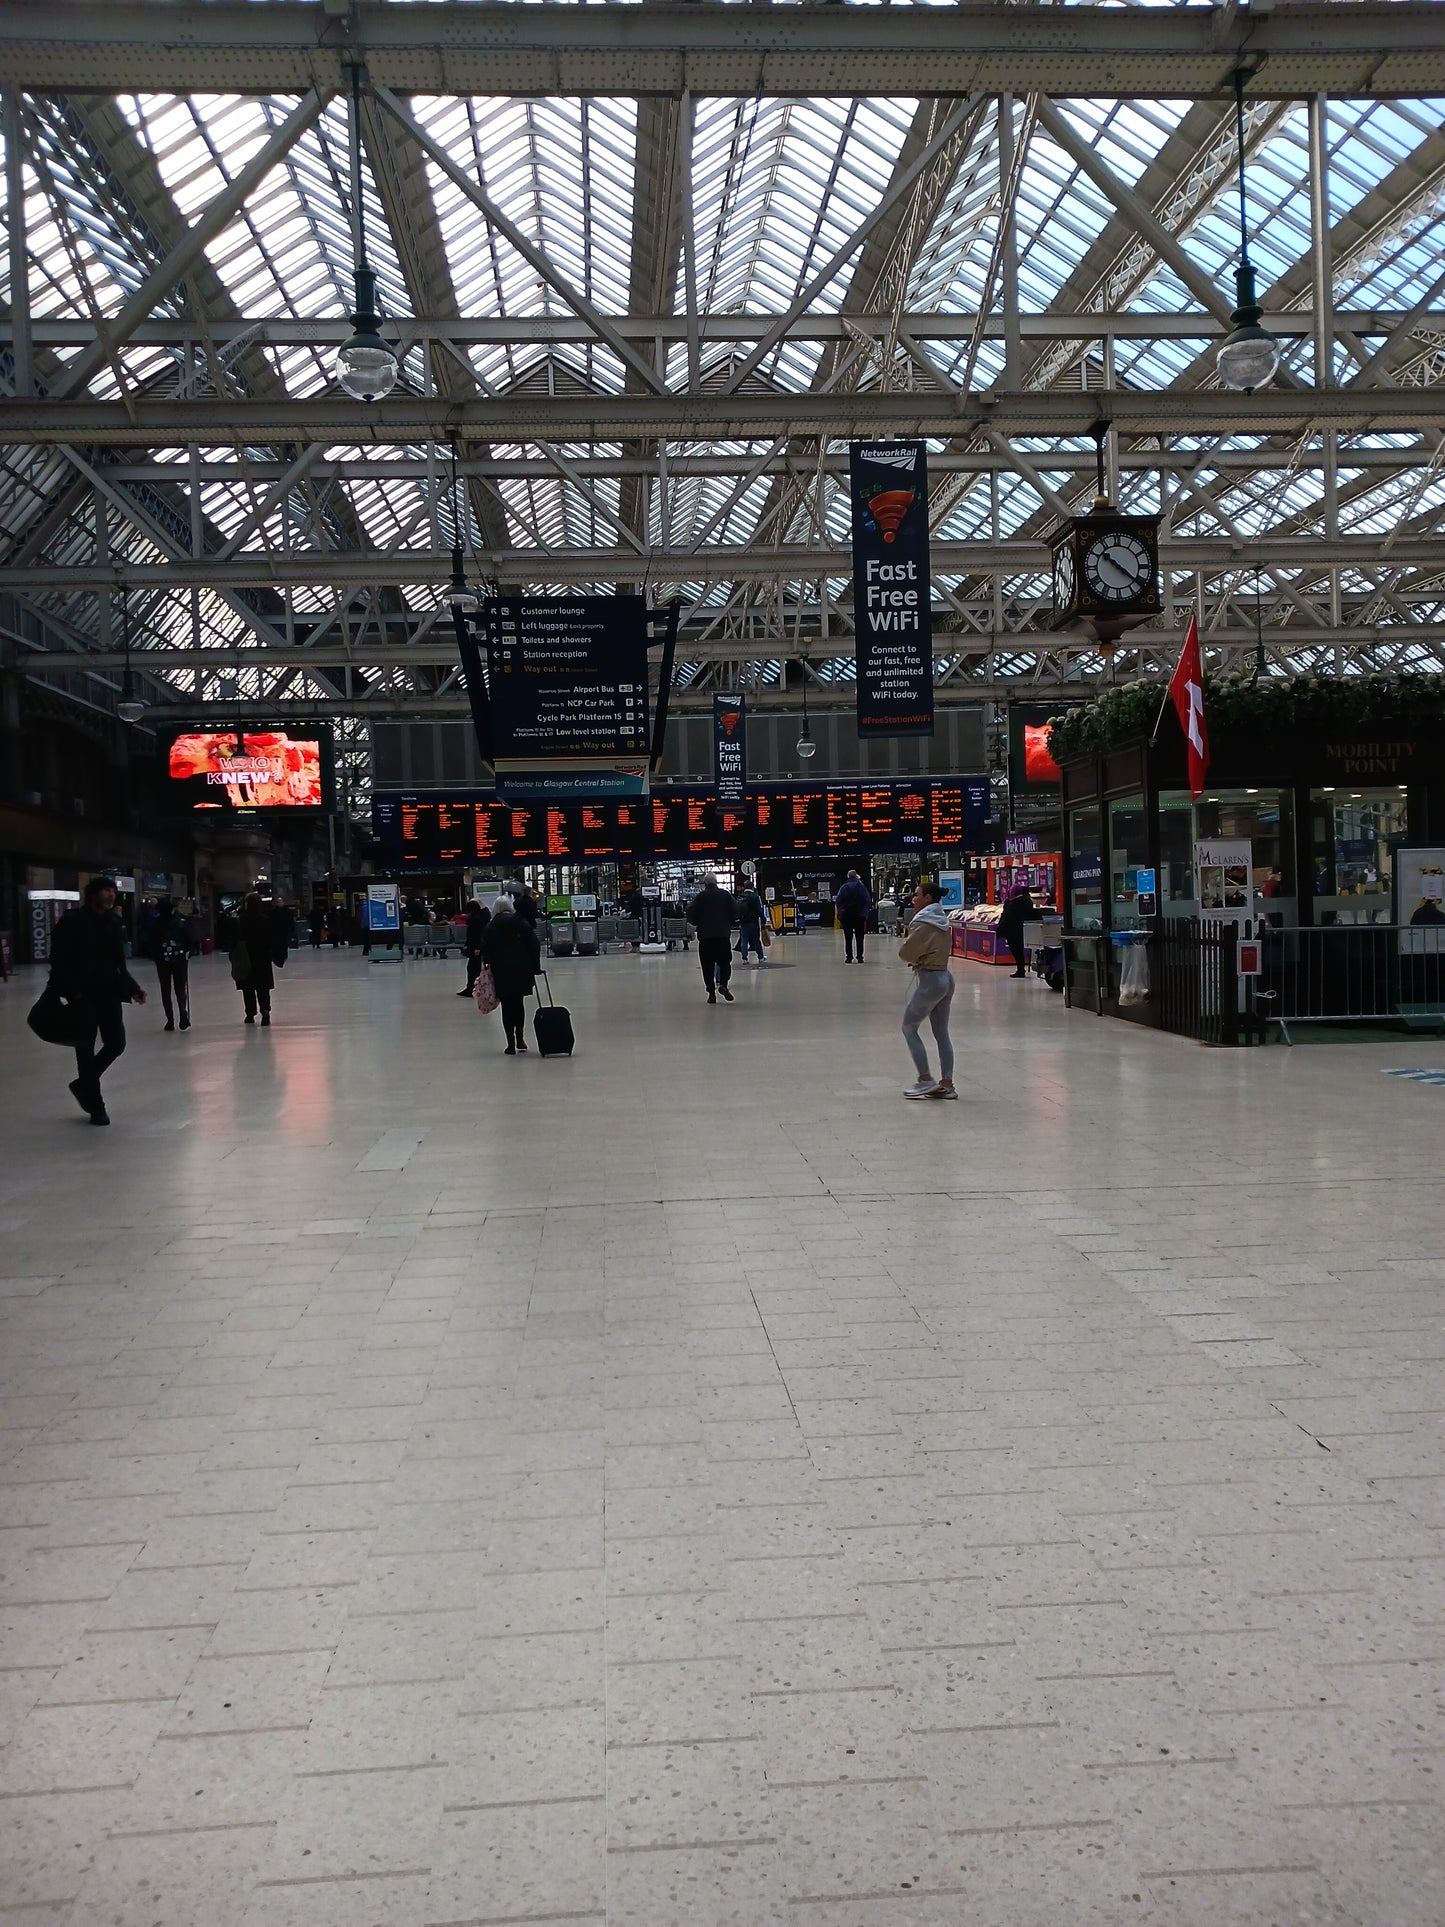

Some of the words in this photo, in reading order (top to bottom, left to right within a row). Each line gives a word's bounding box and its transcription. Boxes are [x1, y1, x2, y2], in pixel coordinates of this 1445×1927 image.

[866, 560, 918, 581] Fast
[867, 586, 918, 607] Free
[521, 607, 558, 615] Customer
[559, 606, 585, 616] lounge
[868, 611, 919, 631] WiFi
[521, 622, 537, 630] Left
[538, 622, 568, 631] luggage
[552, 650, 588, 659] reception
[872, 646, 905, 654] Connect
[884, 657, 902, 665] fast,
[524, 665, 540, 674] Way
[884, 667, 924, 676] unlimited
[893, 691, 919, 699] today.
[537, 714, 558, 722] Cycle
[583, 741, 599, 750] Way
[719, 741, 740, 751] Fast
[1326, 742, 1416, 758] MOBILITY
[719, 752, 741, 762] Free
[720, 762, 741, 771] WiFi
[1345, 759, 1398, 773] POINT
[207, 771, 282, 785] KNEW?
[543, 780, 573, 789] Glasgow
[1073, 869, 1092, 879] CHARGING
[32, 901, 46, 959] PHOTOS
